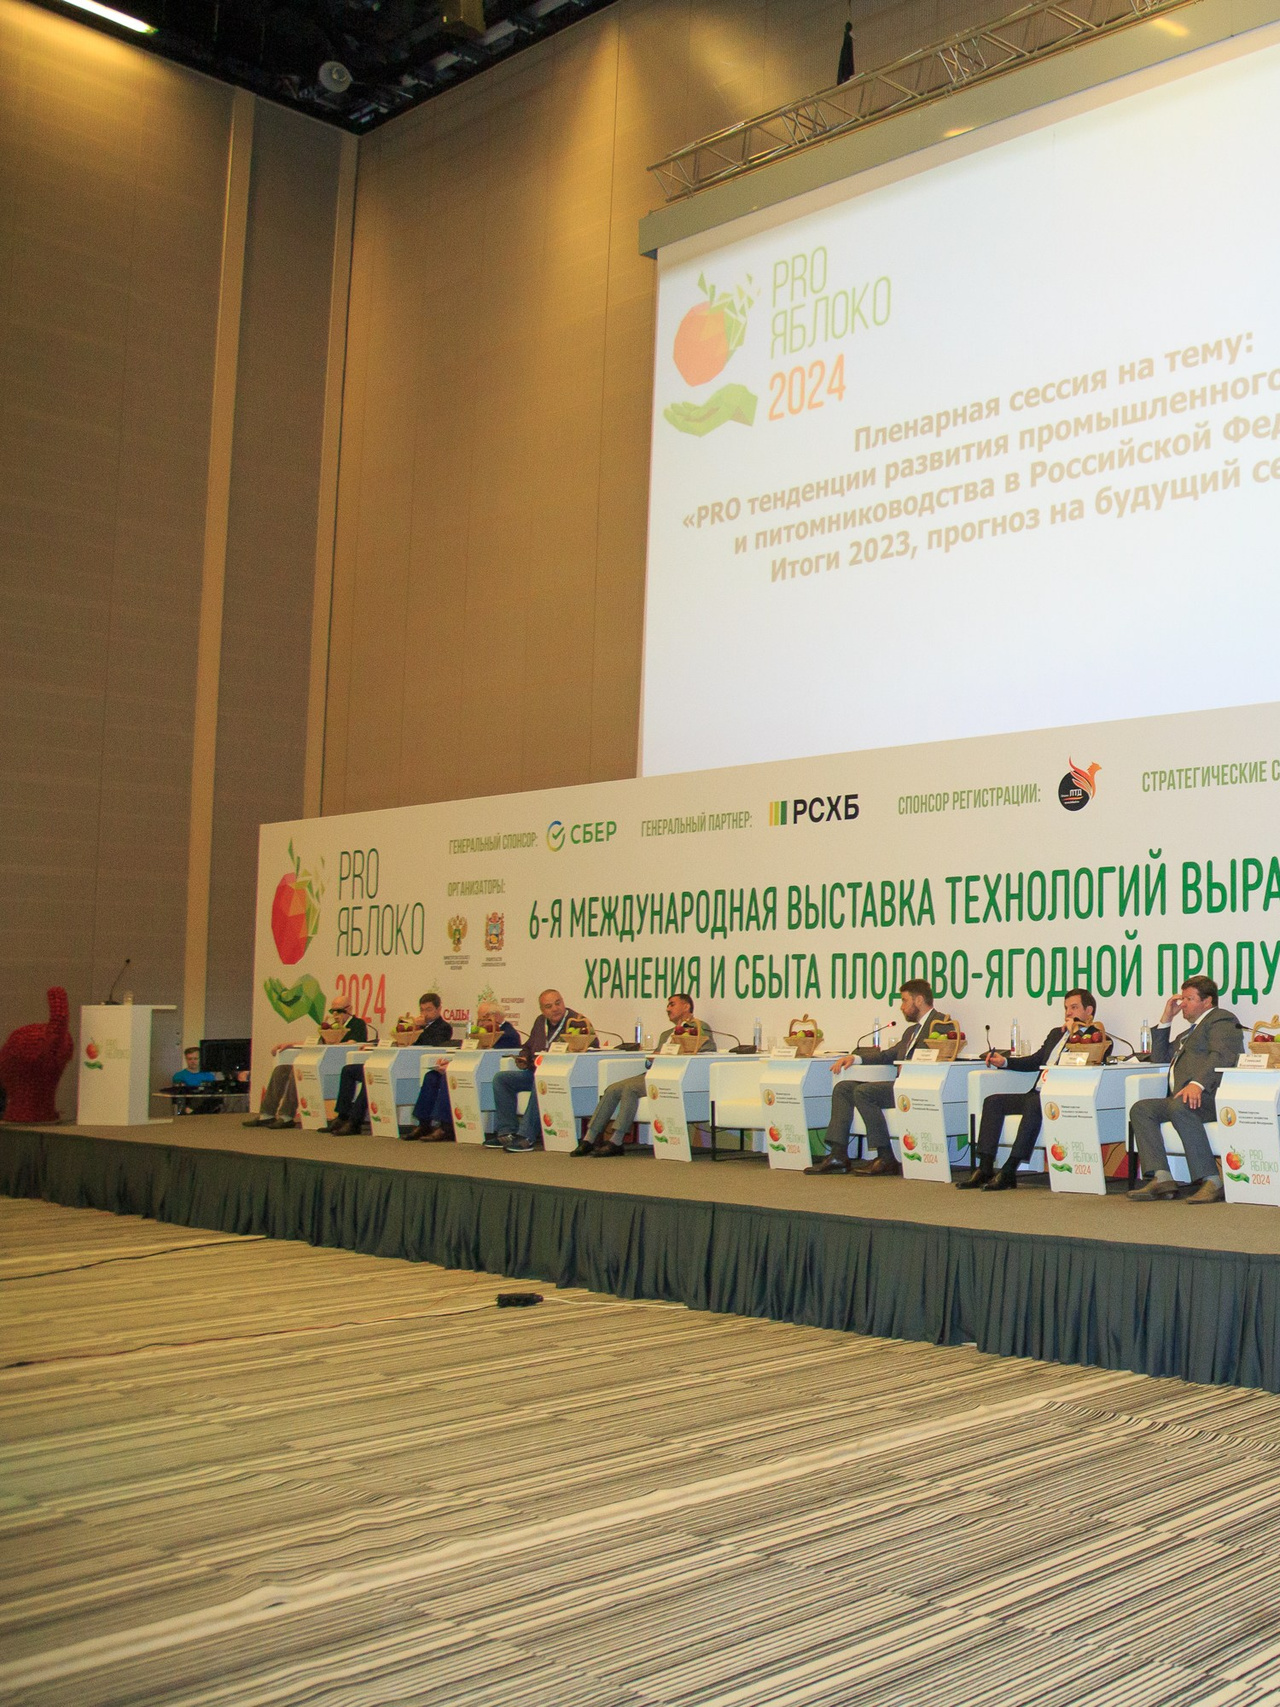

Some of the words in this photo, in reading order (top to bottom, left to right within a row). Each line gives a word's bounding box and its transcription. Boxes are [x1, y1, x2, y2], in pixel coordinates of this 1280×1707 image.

[771, 245, 829, 307] PRO
[770, 276, 892, 360] ЯБЛОКО
[768, 353, 847, 421] 2024
[853, 396, 1000, 453] Пленарная
[1009, 368, 1107, 412] сессия
[1118, 356, 1154, 386] на
[1163, 331, 1254, 373] тему:
[682, 494, 740, 531] «PRO
[747, 466, 876, 516] тенденции
[884, 431, 1009, 490] развития
[734, 534, 747, 555] и
[754, 476, 994, 553] питомниководства
[1003, 469, 1020, 494] в
[1030, 422, 1211, 488] Российской
[771, 546, 840, 584] Итоги
[848, 530, 917, 568] 2023,
[927, 507, 1041, 551] прогноз
[1050, 495, 1085, 525] на
[1094, 459, 1242, 518] будущий
[1141, 758, 1268, 794] СТРАТЕГИЧЕСКИЕ
[793, 794, 860, 825] РСХБ
[897, 791, 950, 816] СПОНСОР
[952, 783, 1041, 810] РЕГИСТРАЦИИ:
[570, 821, 617, 845] СБЕР
[641, 812, 707, 837] ГЕНЕРАЛЬНЫЙ
[708, 811, 752, 832] ПАРТНЕР:
[449, 833, 501, 855] ГЕНЕРАЛЬНЫЙ
[502, 832, 538, 850] СПОНСОР:
[339, 848, 379, 900] PRO
[447, 879, 506, 897] ОРГАНИЗАТОРЫ:
[529, 898, 562, 940] 6-Я
[570, 886, 777, 943] МЕЖДУНАРОДНАЯ
[787, 878, 935, 930] ВЫСТАВКА
[945, 847, 1166, 925] ТЕХНОЛОГИЙ
[336, 902, 425, 957] ЯБЛОКО
[584, 955, 701, 999] ХРАНЕНИЯ
[710, 954, 726, 999] И
[735, 954, 821, 999] СБЫТА
[831, 929, 1142, 1007] ПЛОДОВО-ЯГОДНОЙ
[443, 1009, 470, 1021] САДЫ
[1074, 1164, 1092, 1175] 2024
[1249, 1149, 1264, 1160] PRO
[1250, 1161, 1279, 1173] ЯБЛОКО
[1252, 1174, 1271, 1185] 2024
